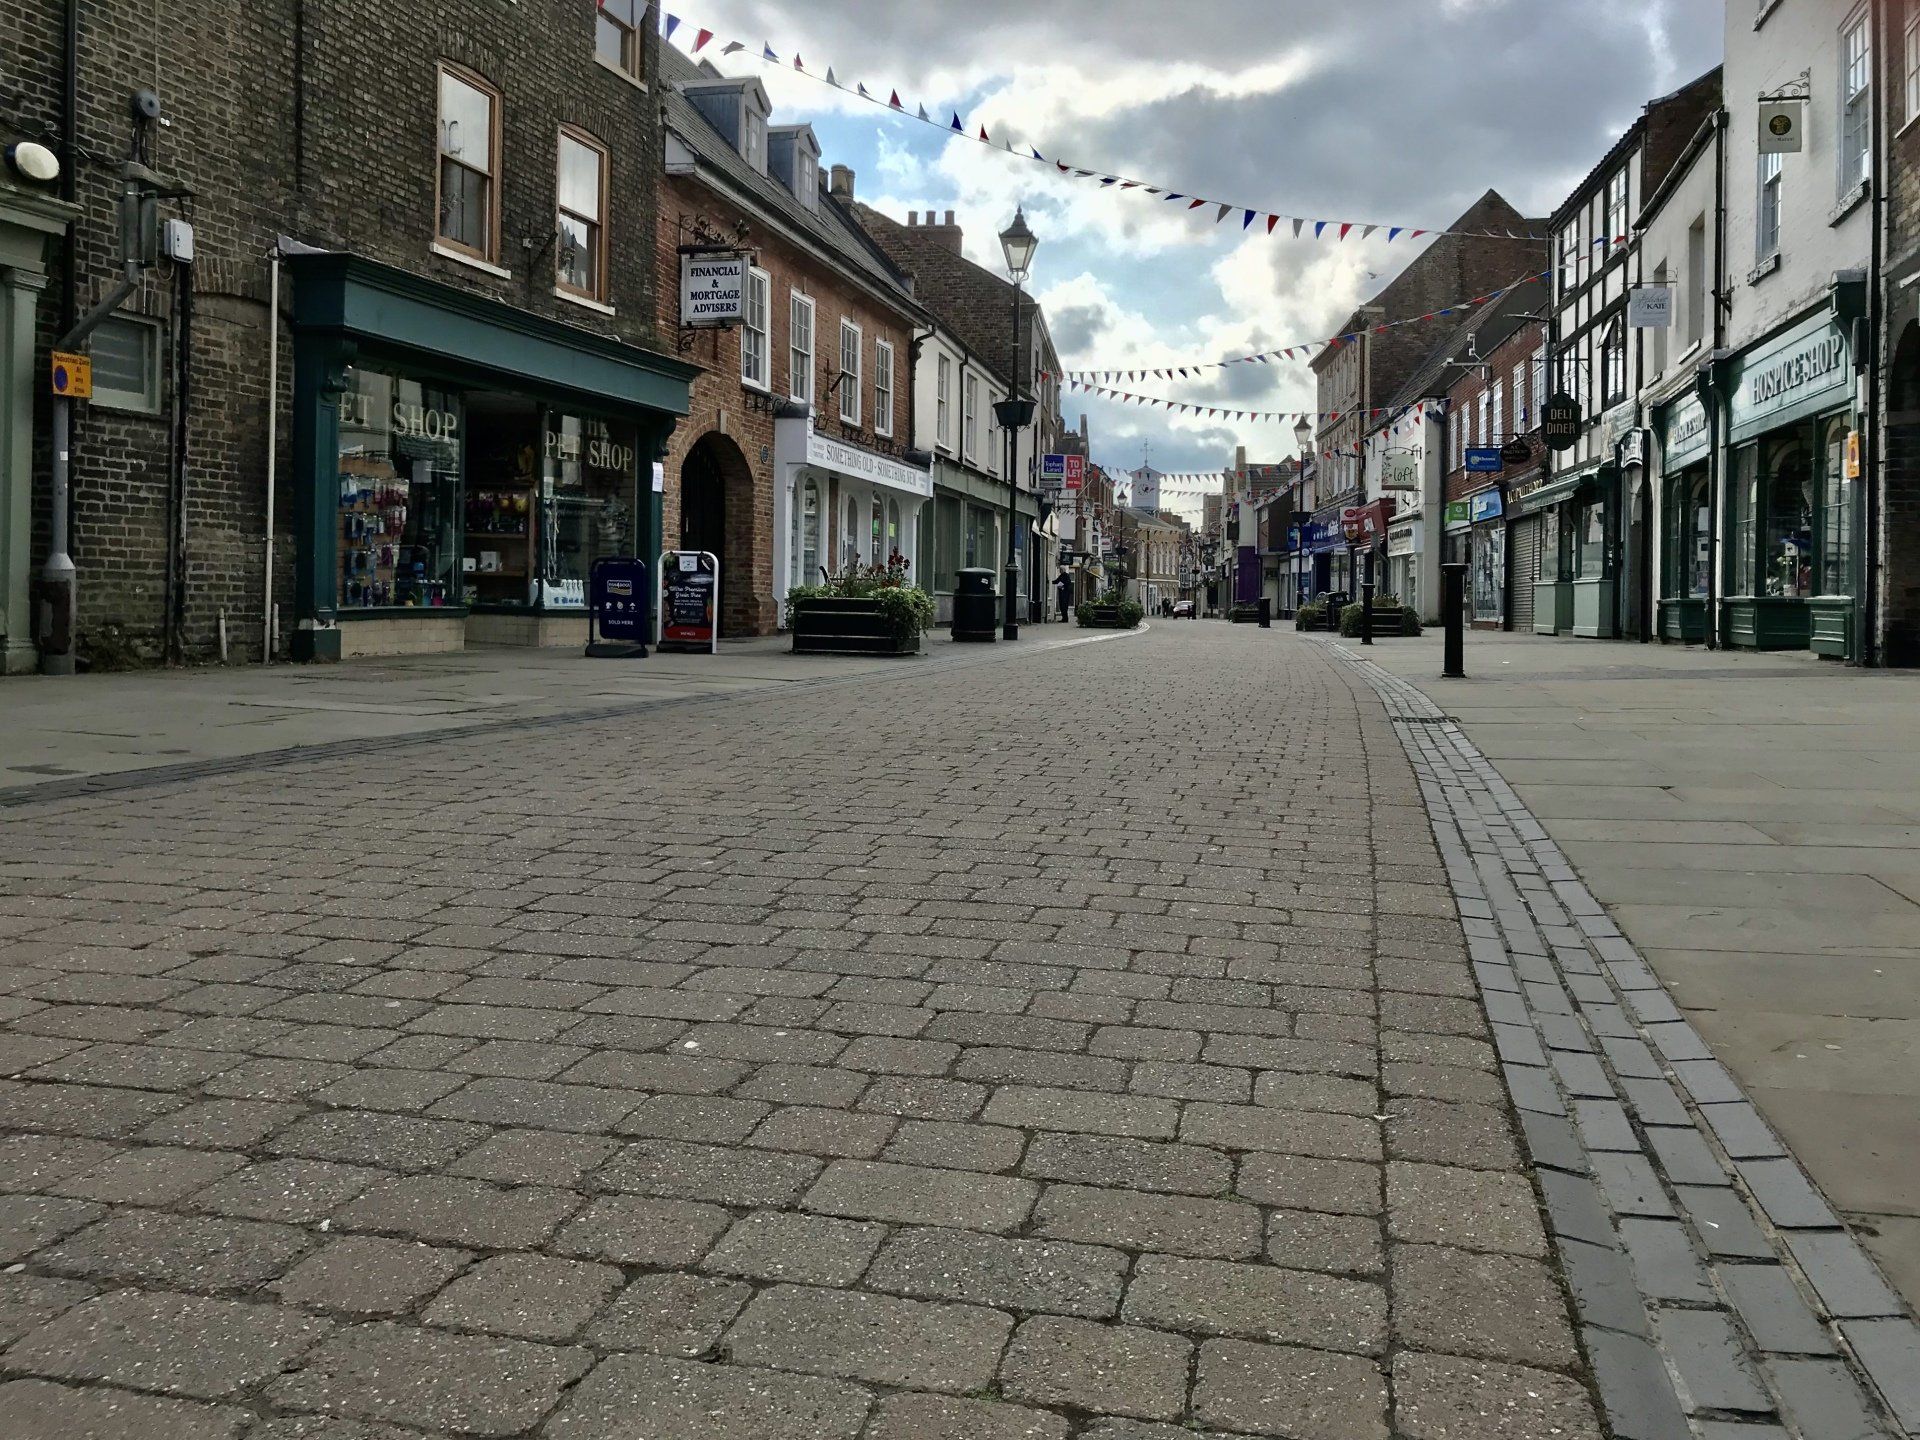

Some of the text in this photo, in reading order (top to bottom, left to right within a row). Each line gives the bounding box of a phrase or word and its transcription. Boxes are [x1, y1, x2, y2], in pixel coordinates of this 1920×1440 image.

[690, 266, 740, 277] FINANCIAL
[711, 278, 719, 289] &
[690, 289, 740, 301] MORTGAGE
[693, 302, 737, 313] ADVISERS
[1753, 334, 1844, 405] HOSPICE SHOP
[338, 391, 458, 444] ET SHOP
[1550, 408, 1572, 420] DELI
[1546, 422, 1576, 435] DINER
[544, 430, 634, 473] PET SHOP
[826, 444, 861, 470] SOMETHING
[862, 456, 874, 473] OLD
[877, 462, 906, 483] SOMETHING
[1069, 460, 1079, 468] TO
[1067, 469, 1081, 477] LET
